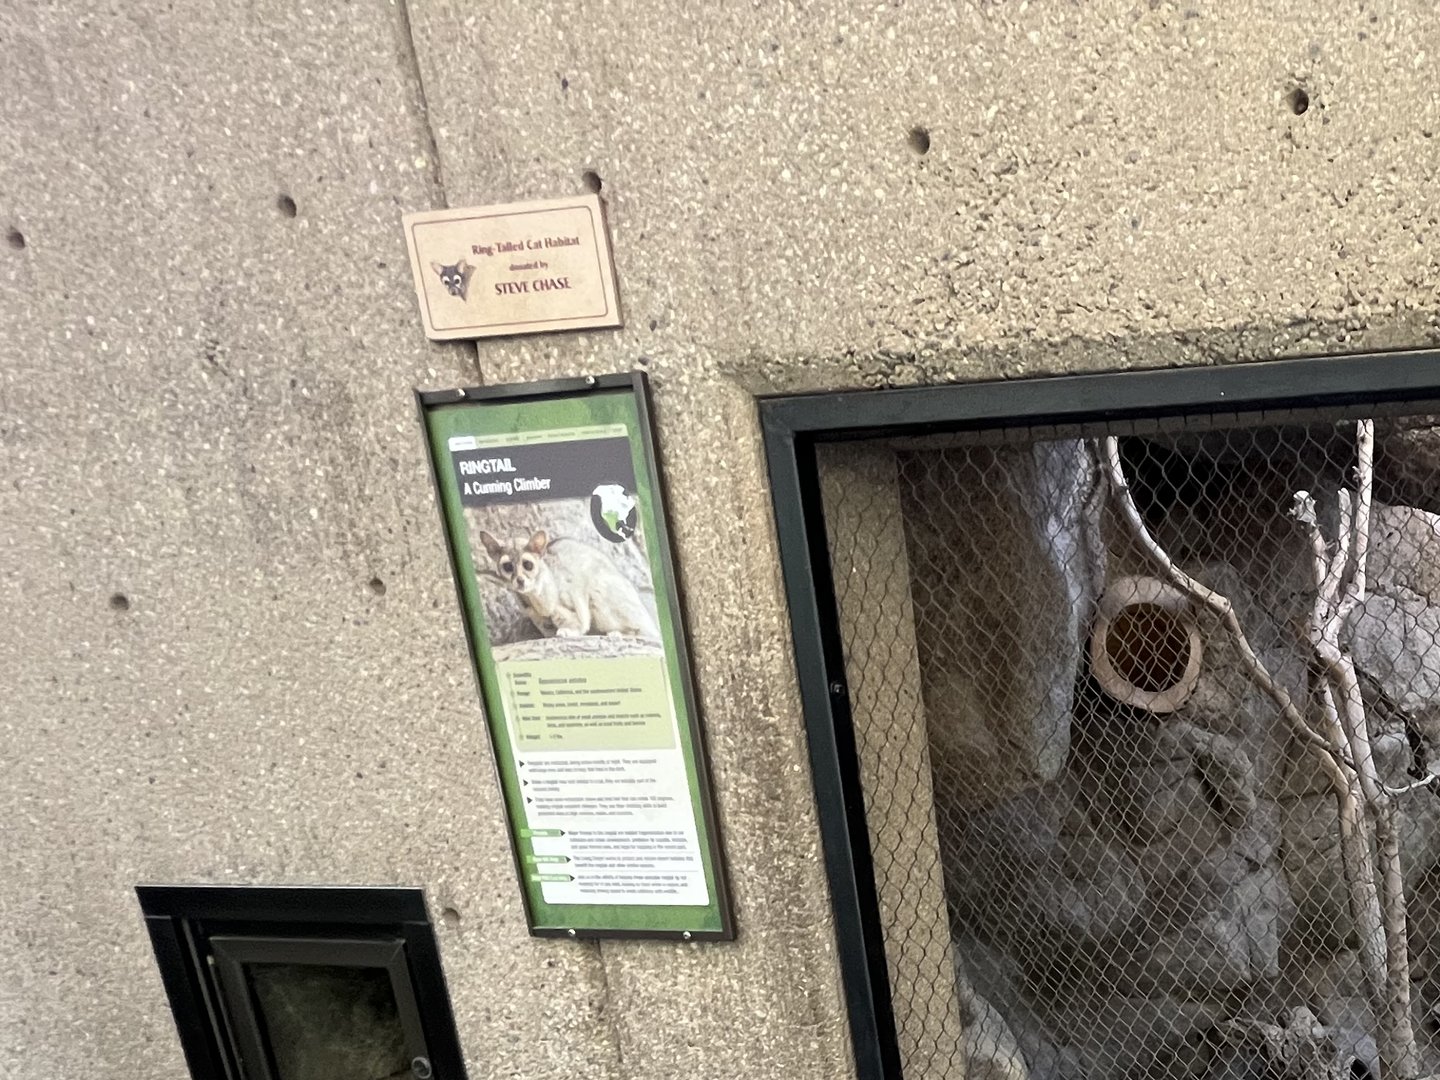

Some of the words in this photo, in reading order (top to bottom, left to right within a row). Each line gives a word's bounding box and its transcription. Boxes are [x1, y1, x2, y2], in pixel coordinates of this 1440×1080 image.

[527, 240, 542, 249] Cat
[545, 236, 580, 248] Habitat
[495, 281, 529, 295] STEVE
[533, 277, 572, 290] CHASE
[460, 458, 516, 475] RINGTAIL
[464, 482, 472, 494] A
[473, 480, 513, 495] Cunning
[514, 477, 551, 492] Climber
